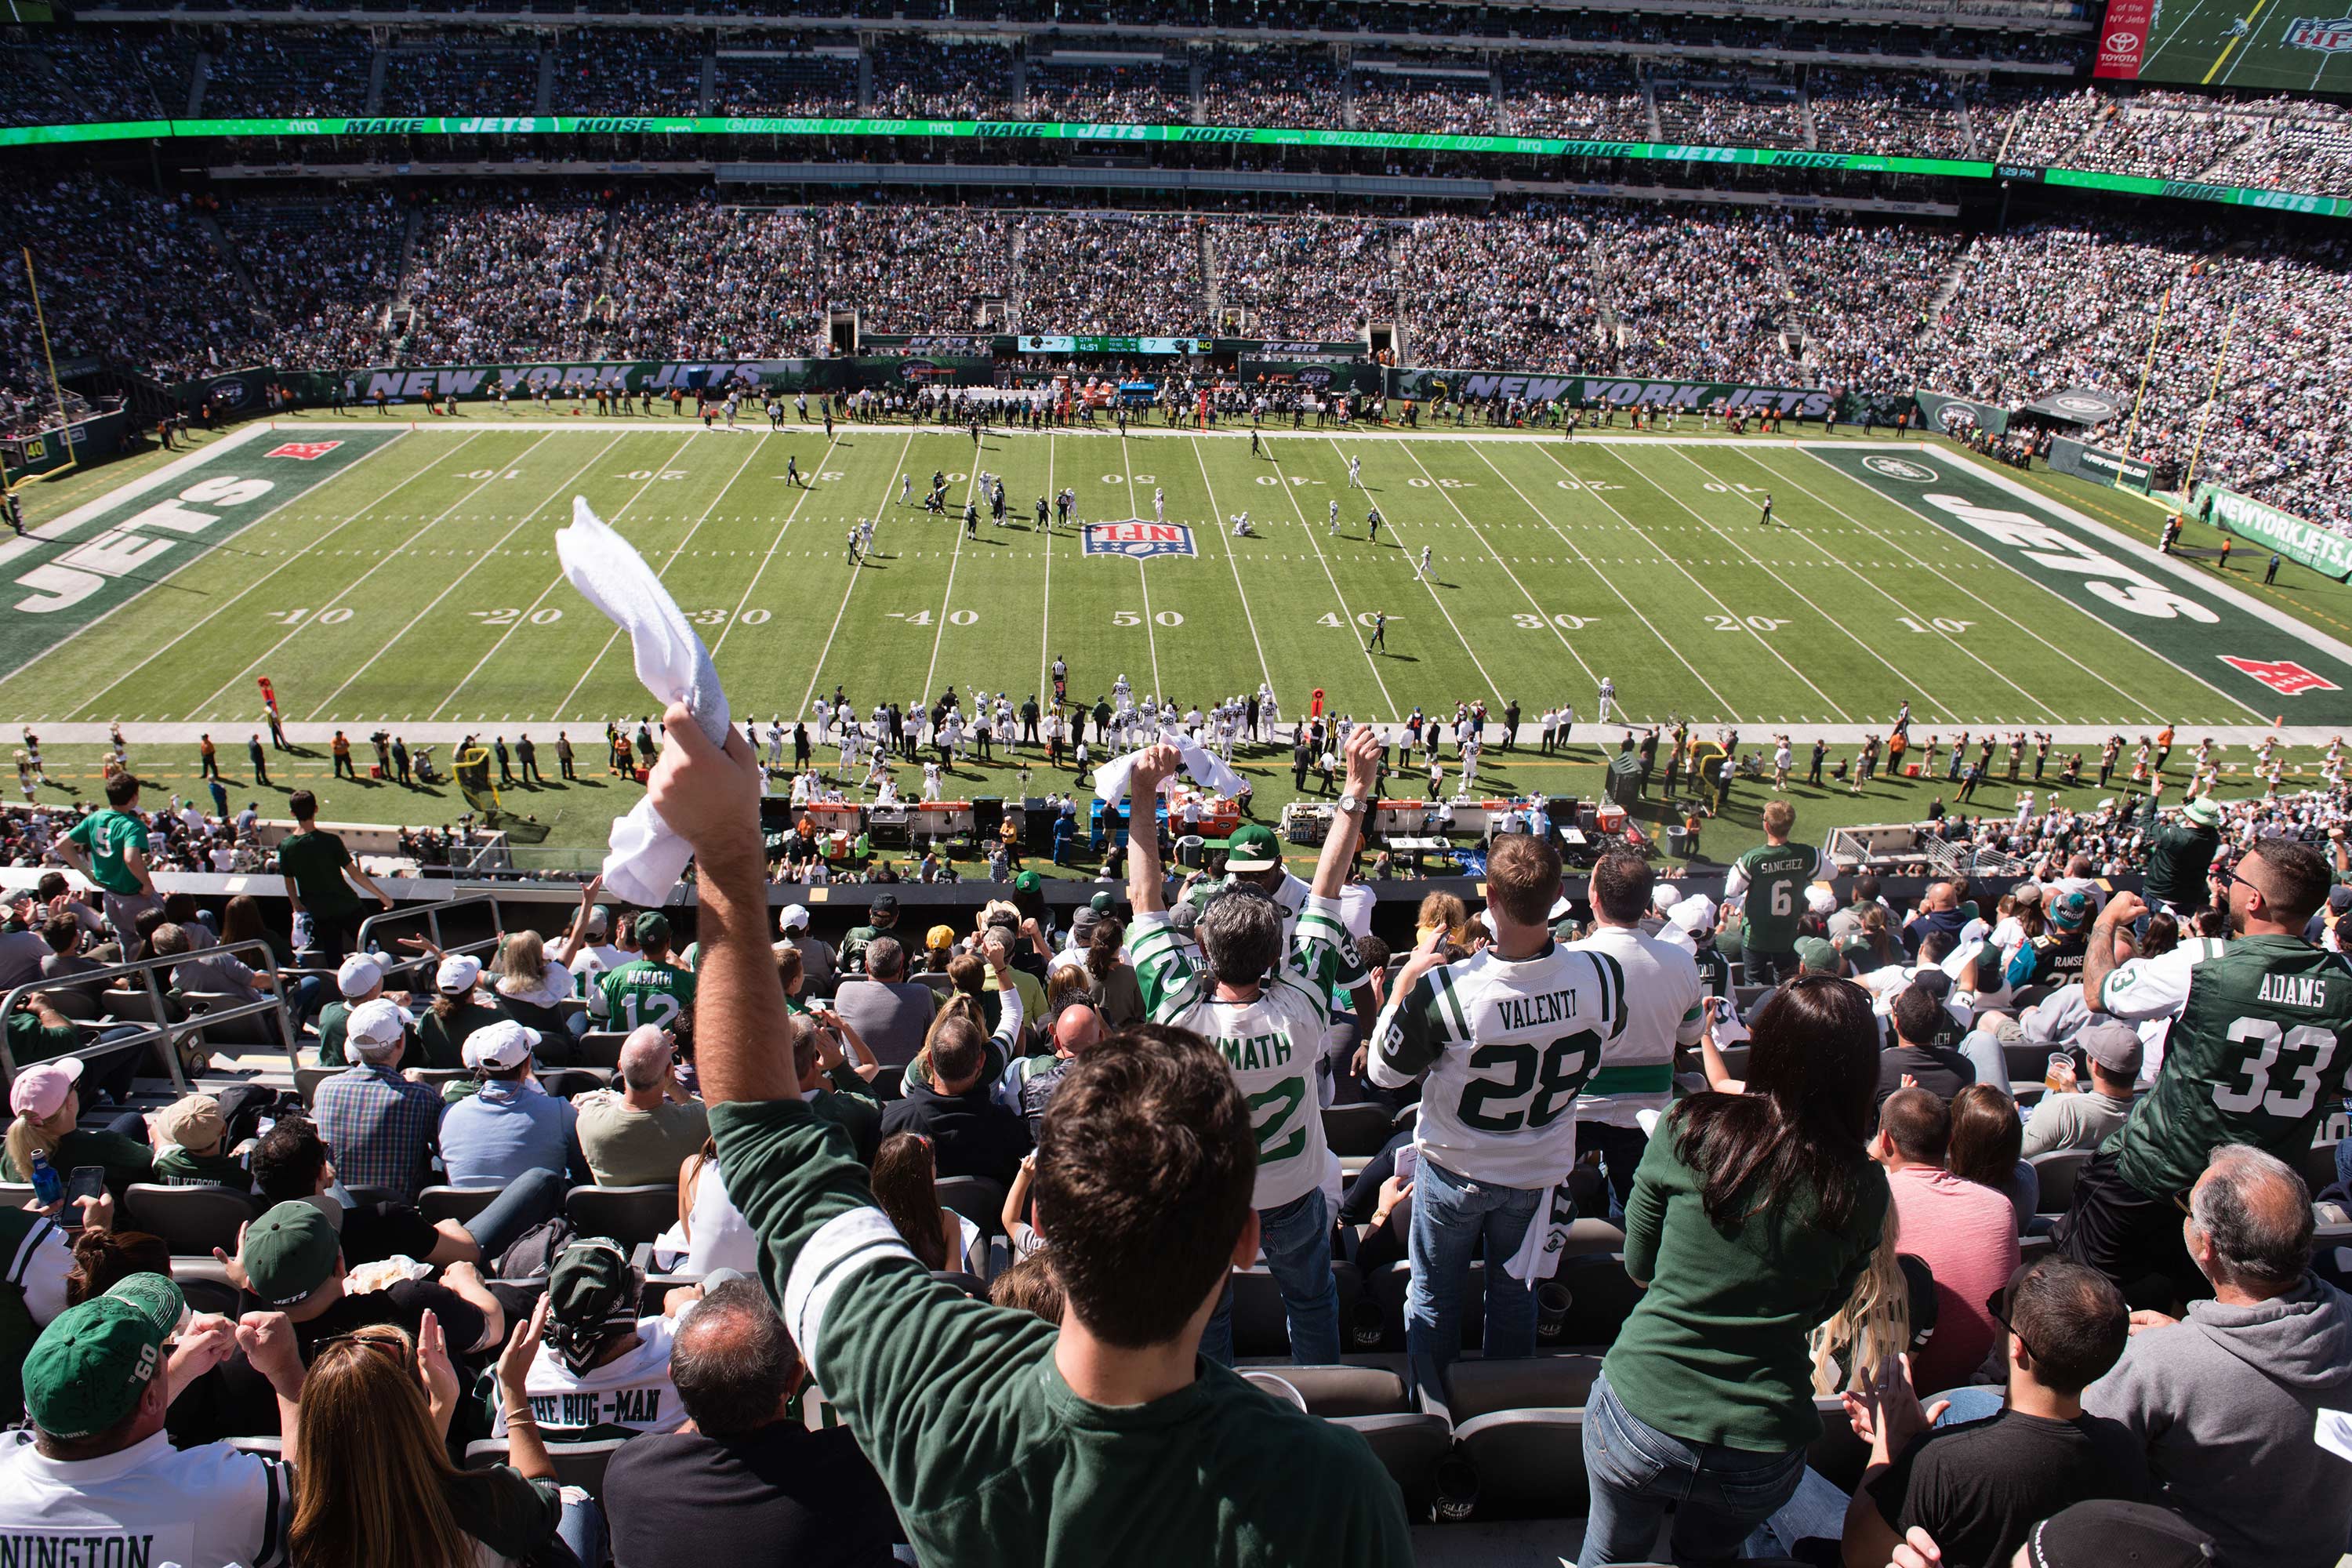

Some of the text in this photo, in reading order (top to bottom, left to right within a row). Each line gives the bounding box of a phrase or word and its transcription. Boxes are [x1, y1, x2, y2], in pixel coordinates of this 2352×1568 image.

[2100, 53, 2138, 63] TOYOTA
[343, 119, 424, 132] MAKE
[459, 118, 535, 132] JETS
[575, 118, 654, 132] NOISE
[725, 118, 906, 133] CRANK IT UP
[973, 122, 1047, 136] MAKE
[1077, 125, 1146, 139] JETS
[1180, 127, 1256, 142] NOISE
[1319, 132, 1494, 150] CRANK IT UP
[1560, 141, 1634, 157] MAKE
[1667, 145, 1737, 161] JETS
[1771, 151, 1851, 168] NOISE
[1998, 165, 2035, 179] 1:29 PM
[2160, 182, 2227, 201] MAKE
[2253, 191, 2320, 212] JETS
[1058, 338, 1066, 348] 7
[1149, 339, 1156, 350] 7
[1198, 339, 1212, 350] 40
[1283, 343, 1319, 352] JETS
[365, 369, 489, 397] NEW
[495, 365, 633, 393] YORK
[1467, 376, 1835, 416] NEW YORK JETS
[27, 441, 43, 459] 40
[1104, 523, 1181, 542] NFL
[14, 475, 275, 614] JETS
[1922, 493, 2220, 624] JETS
[276, 608, 355, 626] 10
[481, 608, 564, 625] 20
[904, 608, 979, 626] 40
[1112, 610, 1185, 627] 50
[1511, 613, 1588, 630] 30
[1704, 615, 1779, 633] 20
[1895, 616, 1968, 633] 10
[1118, 686, 1127, 695] 97
[1603, 688, 1613, 698] 14
[818, 706, 824, 714] 9
[916, 710, 925, 719] 49
[1127, 713, 1136, 721] 85
[1145, 708, 1153, 717] 96
[1265, 708, 1274, 717] 20
[949, 717, 958, 727] 48
[1163, 717, 1174, 726] 98
[1341, 724, 1349, 733] 15
[1468, 746, 1479, 756] 42
[1609, 818, 1618, 829] G
[1760, 858, 1803, 874] SANCHEZ
[1770, 880, 1792, 916] 6
[626, 970, 673, 985] NAMATH
[2257, 974, 2326, 1008] ADAMS
[620, 993, 680, 1032] 12
[1497, 989, 1577, 1032] VALENTI
[1206, 1032, 1292, 1071] MATH
[2211, 1015, 2338, 1119] 33
[1456, 1028, 1602, 1132] 28
[1245, 1076, 1306, 1166] 2
[273, 1290, 307, 1305] JETS
[134, 1342, 158, 1381] 60
[526, 1388, 661, 1426] THE BUG -MAN
